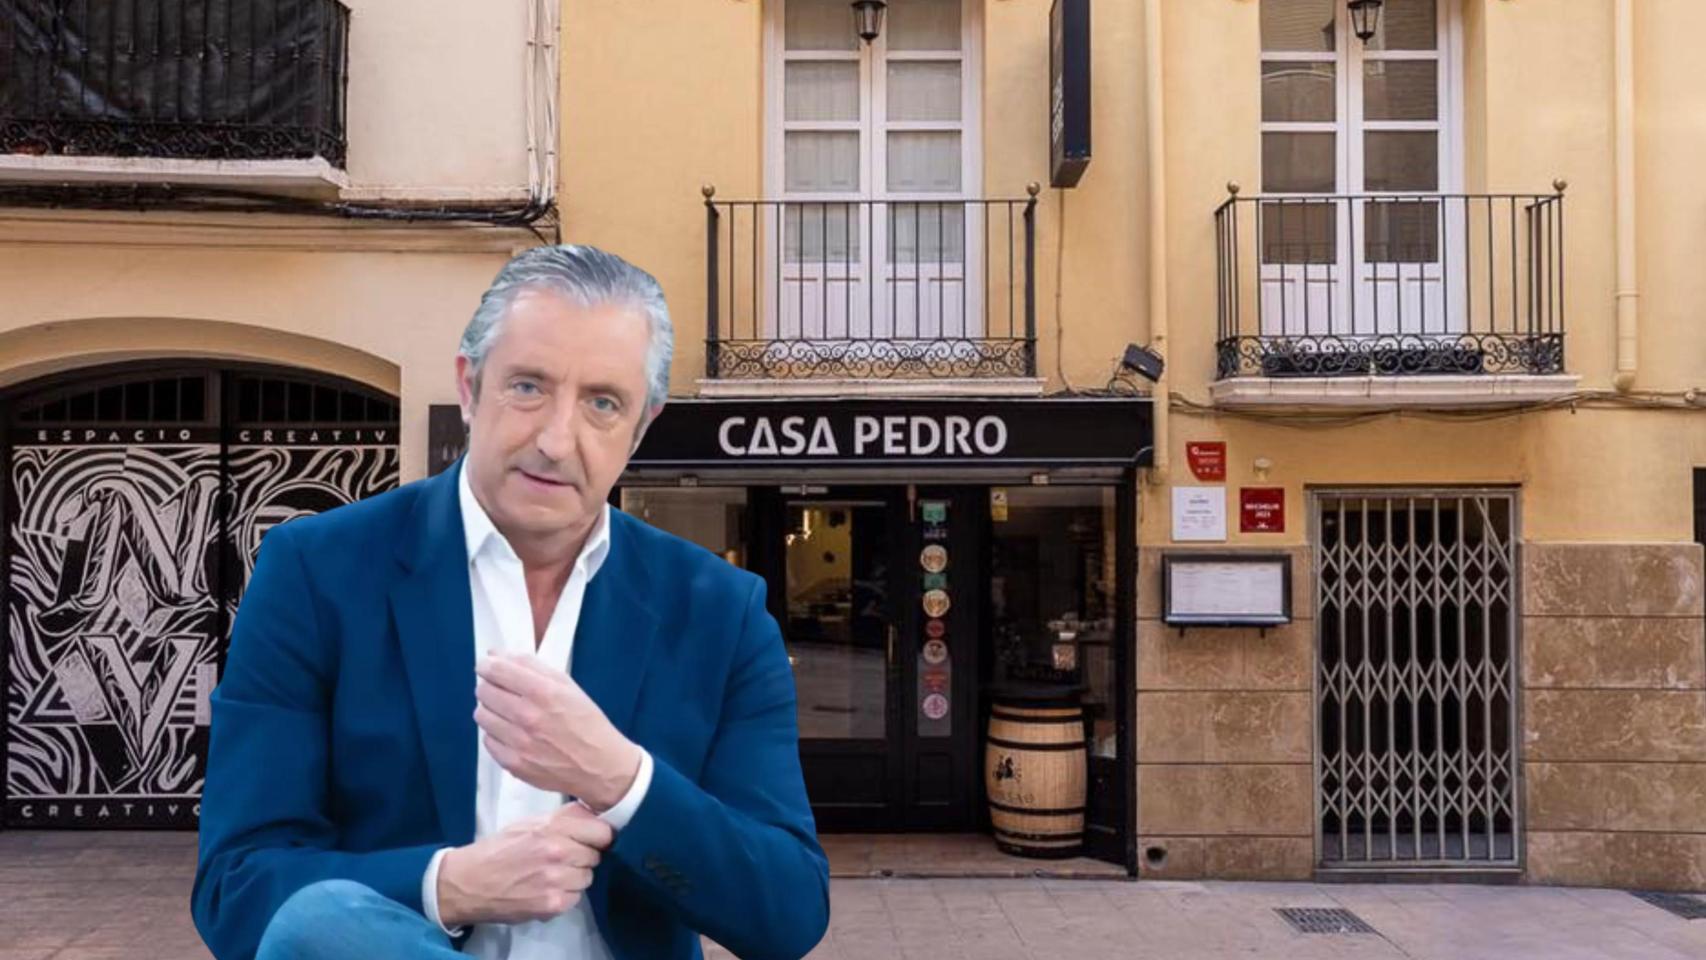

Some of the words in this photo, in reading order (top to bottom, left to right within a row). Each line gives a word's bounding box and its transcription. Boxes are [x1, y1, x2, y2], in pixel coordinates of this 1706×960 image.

[38, 429, 191, 442] ESPACIO
[239, 430, 386, 443] CREATIV
[718, 416, 839, 456] CASA
[853, 416, 1008, 456] PEDRO
